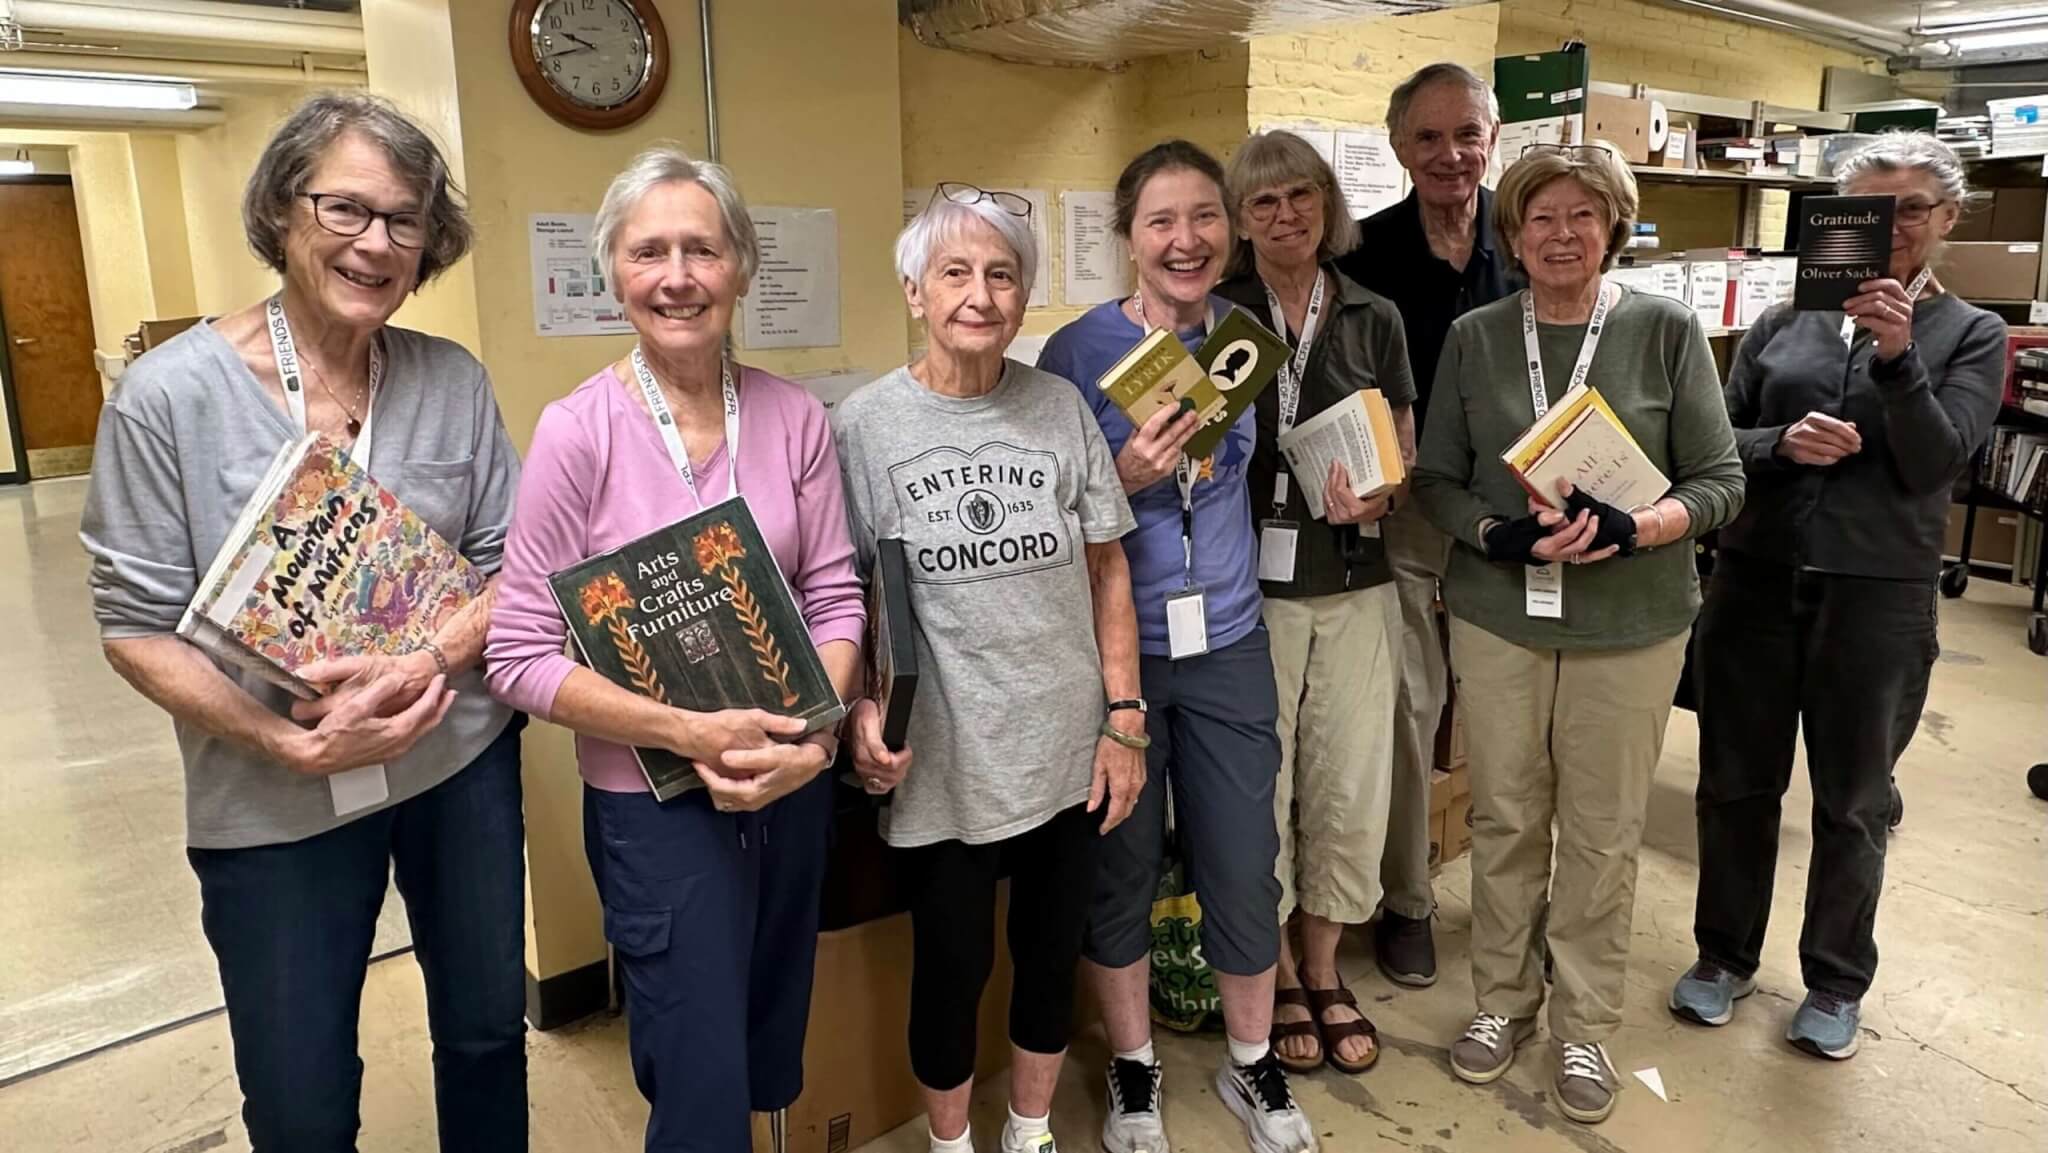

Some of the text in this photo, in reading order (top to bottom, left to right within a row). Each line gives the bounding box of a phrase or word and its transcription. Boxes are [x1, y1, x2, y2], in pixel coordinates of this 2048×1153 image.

[550, 15, 562, 30] 10
[563, 2, 575, 16] 11
[620, 19, 630, 32] 2
[553, 59, 562, 73] 8
[624, 64, 633, 76] 4
[572, 76, 581, 89] 7
[592, 82, 601, 96] 6
[611, 78, 621, 91] 5
[1810, 211, 1880, 226] Gratitude
[1801, 267, 1880, 279] Oliver Sacks
[271, 317, 297, 376] FRIENDS
[637, 364, 666, 413] FRIENDS
[1124, 353, 1176, 396] LYRIK
[1532, 371, 1545, 407] FRIENDS
[724, 389, 738, 418] CFPL
[905, 464, 1046, 502] ENTERING
[927, 500, 1034, 523] EST. 1635
[272, 522, 298, 551] A
[271, 493, 348, 610] Mountain
[636, 549, 681, 581] Arts
[918, 531, 1059, 573] CONCORD
[289, 496, 379, 639] of Mittens
[650, 569, 679, 590] and
[639, 576, 706, 614] Crafts
[626, 585, 737, 643] Furniture
